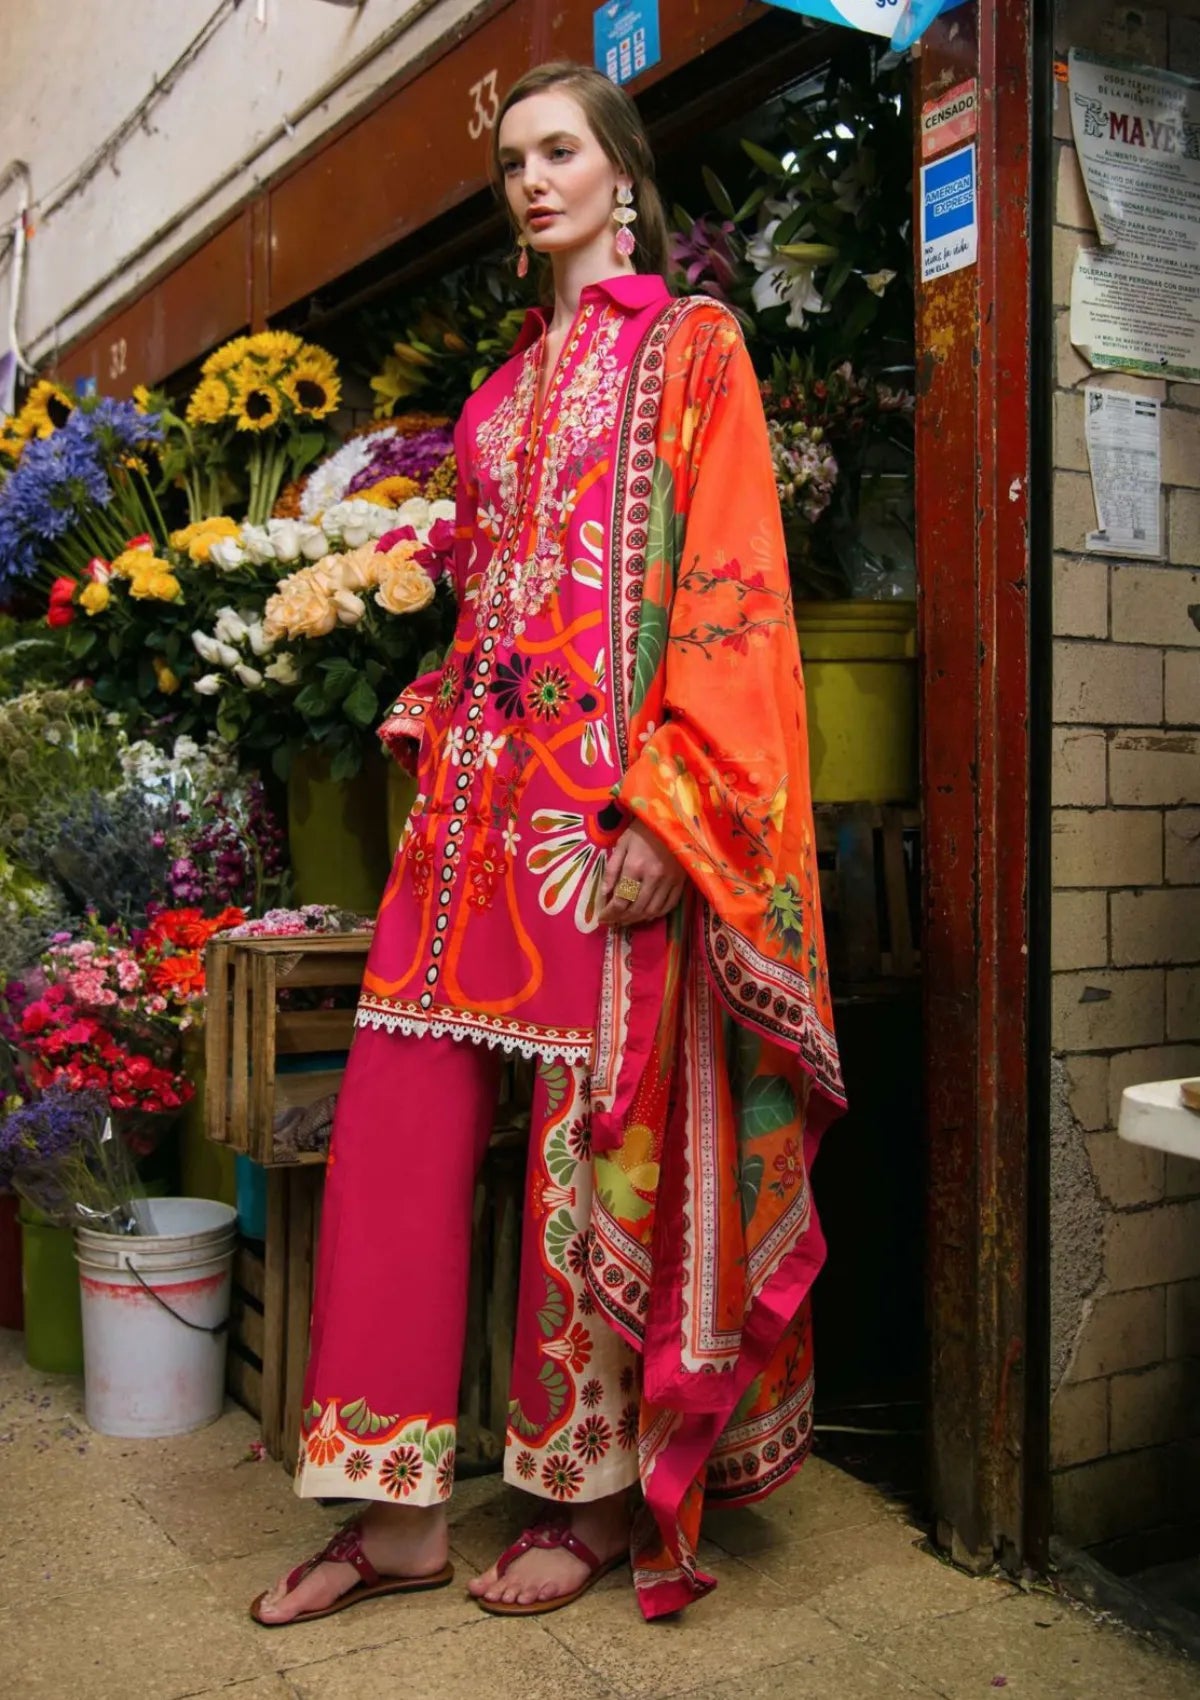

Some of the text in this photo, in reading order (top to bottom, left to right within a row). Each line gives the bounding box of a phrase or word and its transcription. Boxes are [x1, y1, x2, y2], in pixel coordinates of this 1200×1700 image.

[467, 69, 499, 139] 33
[1098, 84, 1108, 95] DE
[1111, 88, 1121, 98] LA
[925, 96, 974, 129] CENSADO
[925, 174, 971, 206] AMERICAN
[933, 191, 974, 217] EXPRESS
[925, 246, 934, 254] NO
[925, 262, 949, 277] SIN ELLA
[1079, 266, 1112, 278] TOLERADA
[1114, 271, 1128, 280] POR
[1129, 274, 1162, 287] PERSONAS
[1164, 281, 1177, 290] CON
[108, 337, 127, 380] 32
